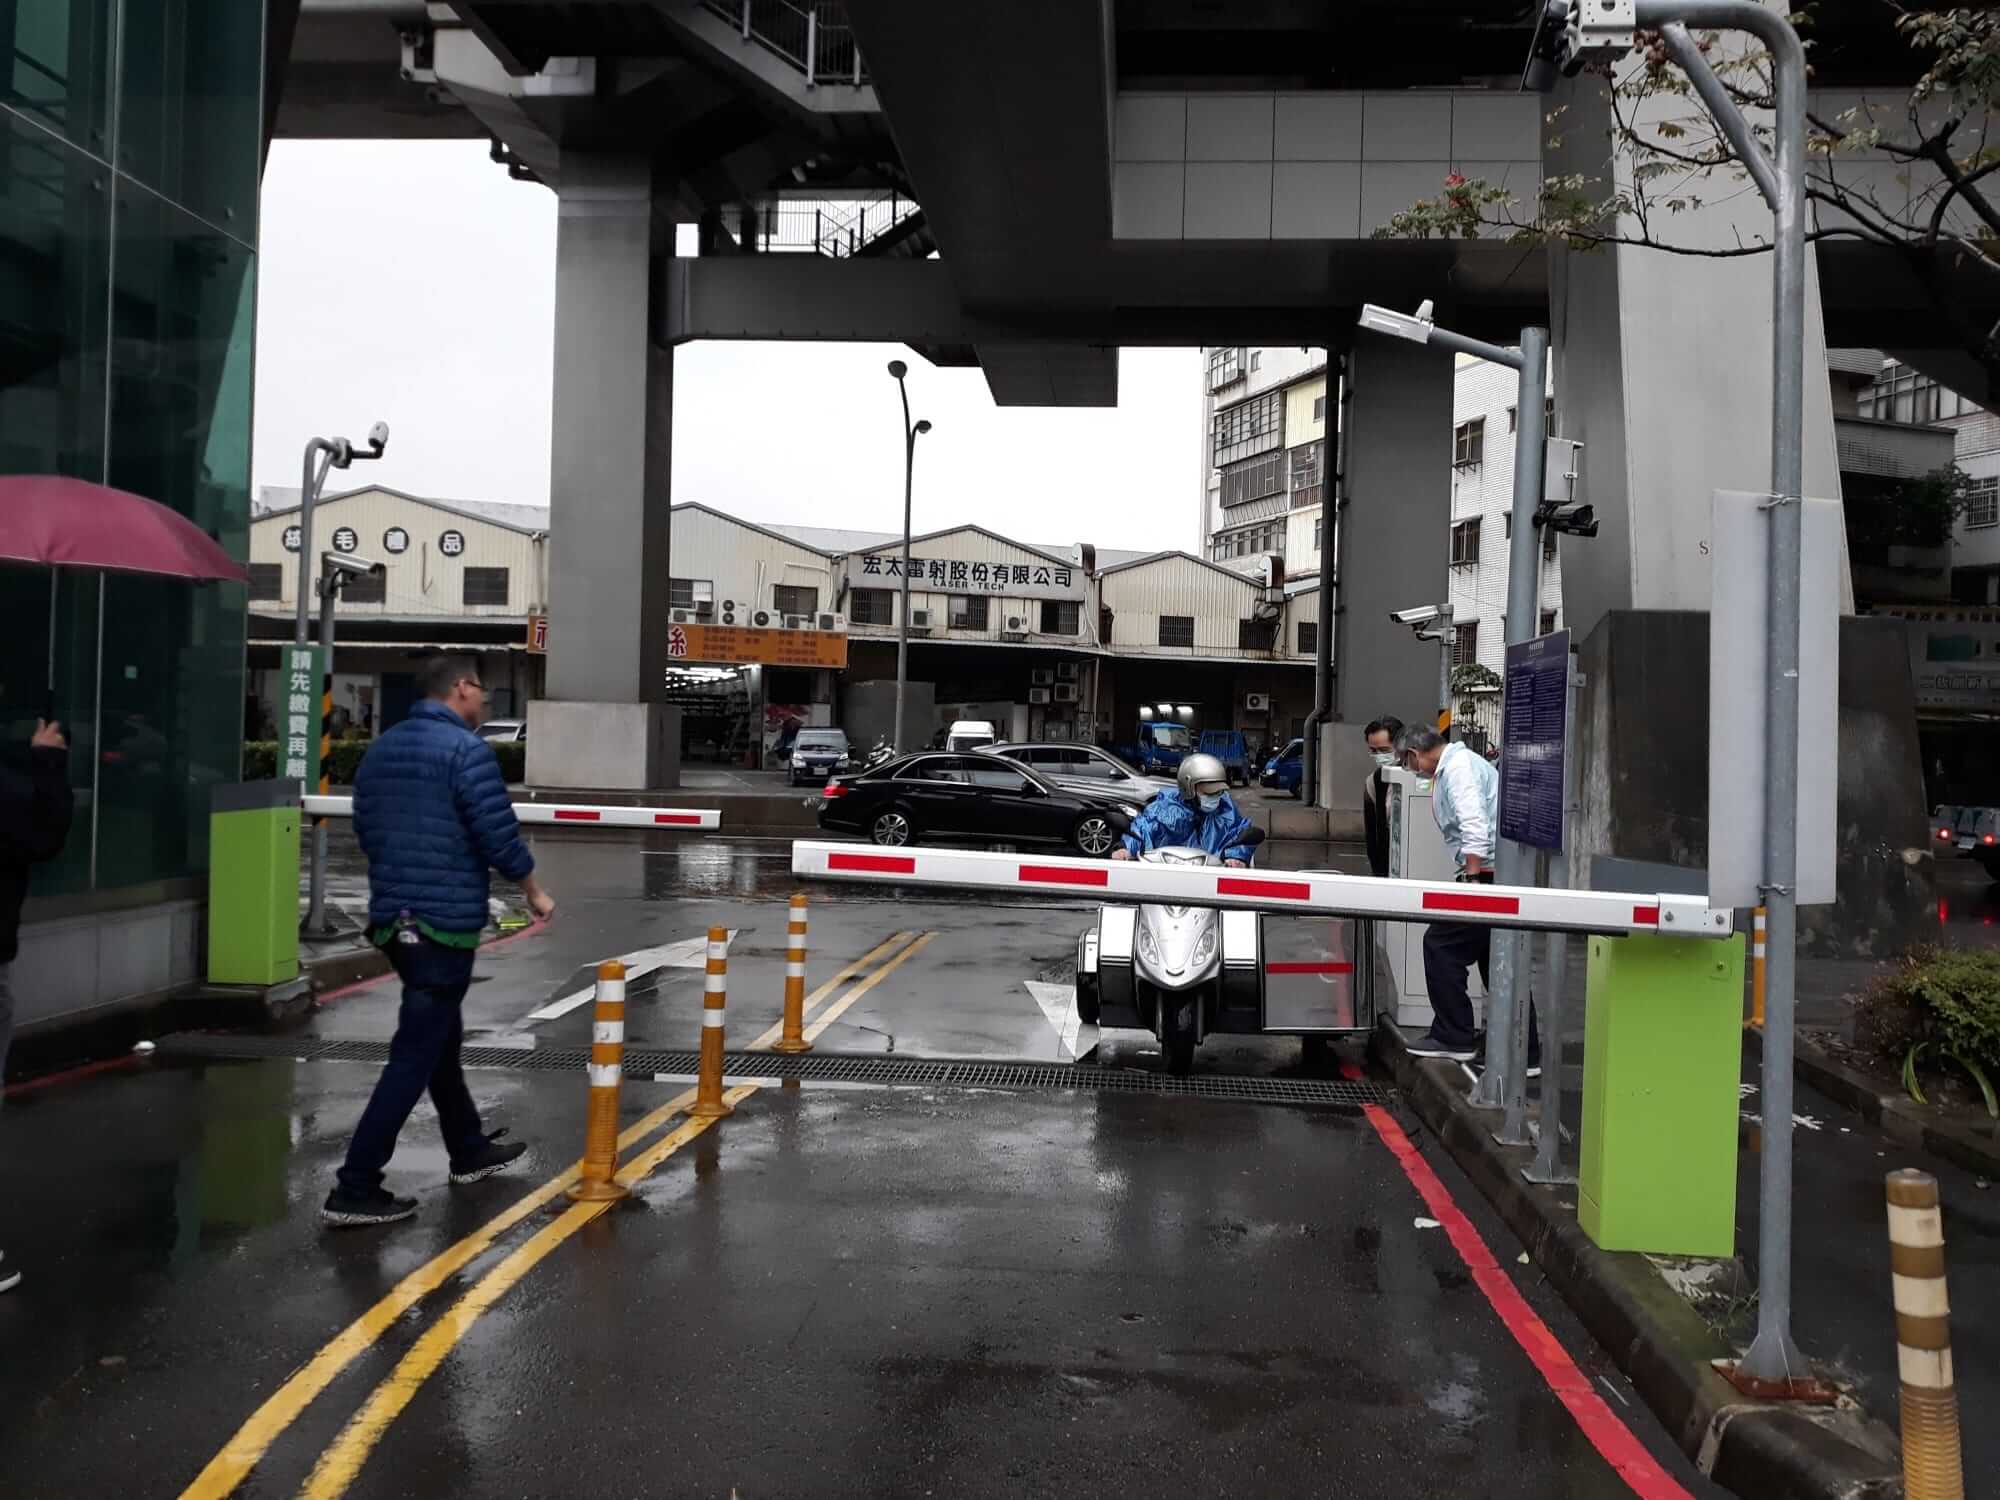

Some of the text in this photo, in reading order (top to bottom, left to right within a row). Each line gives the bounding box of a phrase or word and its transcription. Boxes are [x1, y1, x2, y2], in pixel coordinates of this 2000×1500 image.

[863, 555, 1072, 587] 宏太雷射股份有限公司
[285, 650, 312, 797] 請先繳費再離
